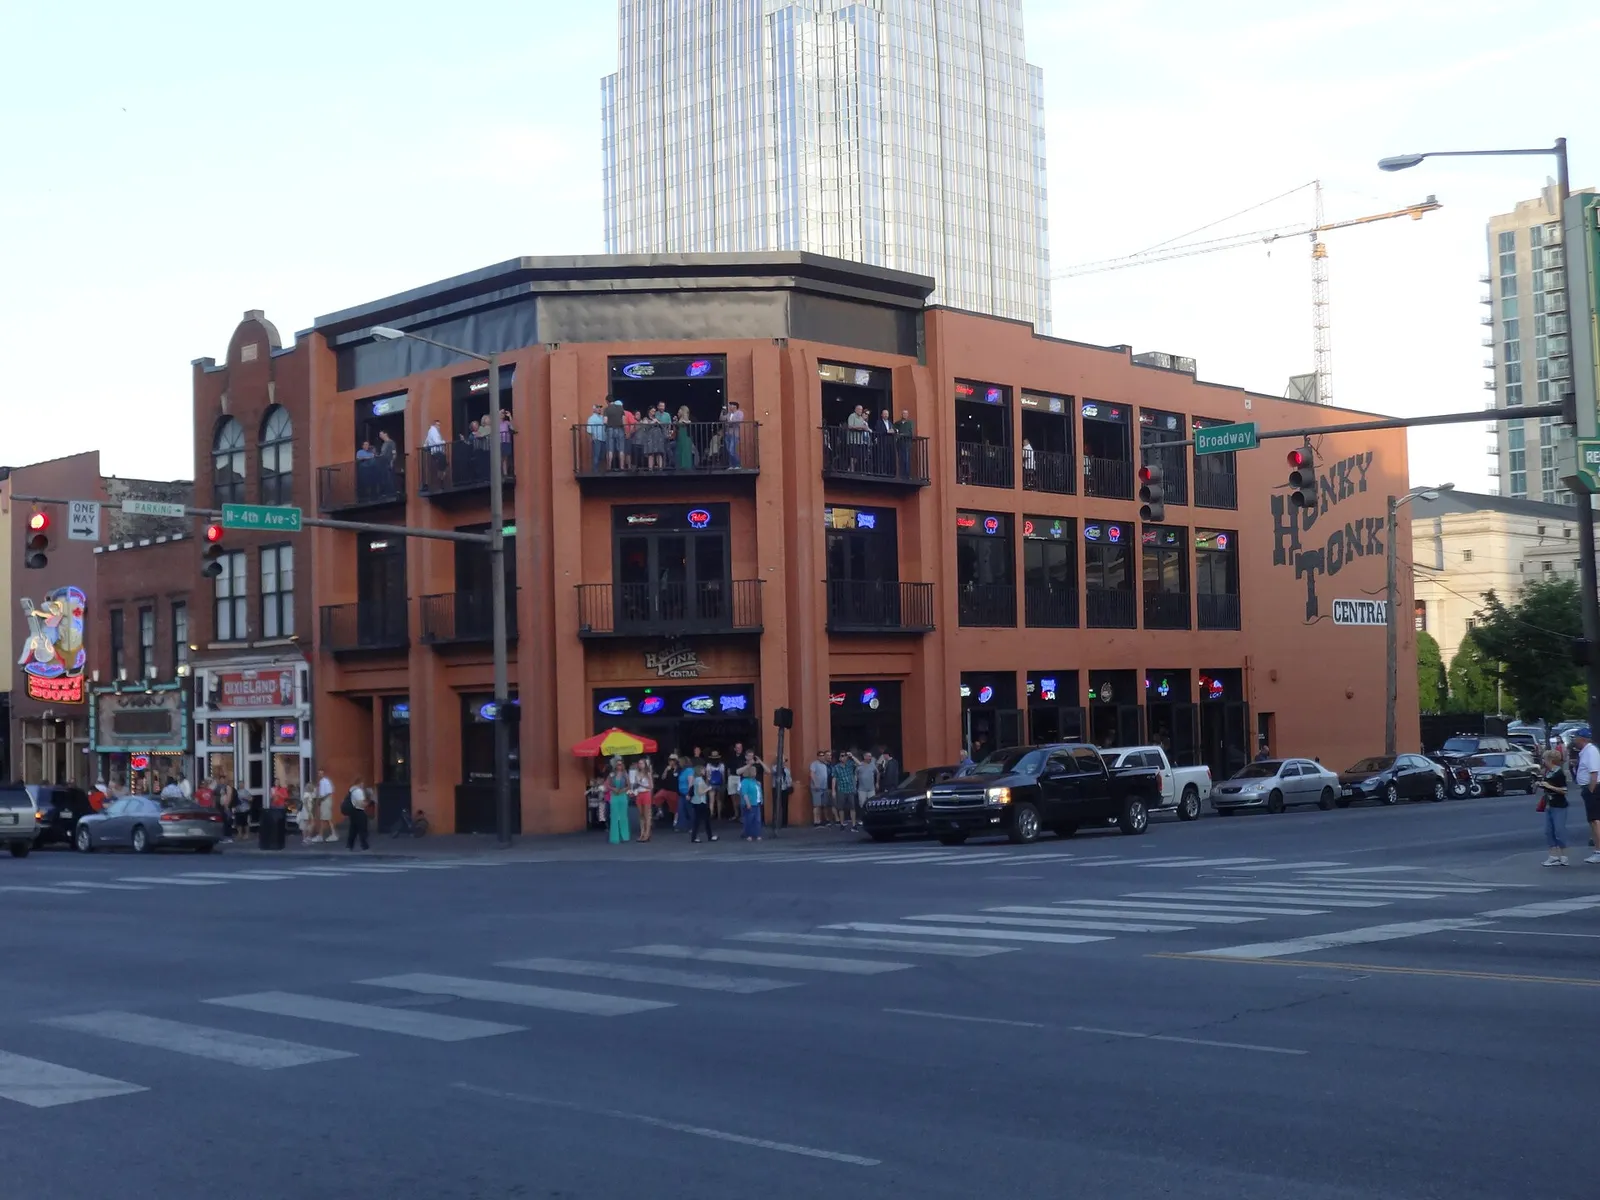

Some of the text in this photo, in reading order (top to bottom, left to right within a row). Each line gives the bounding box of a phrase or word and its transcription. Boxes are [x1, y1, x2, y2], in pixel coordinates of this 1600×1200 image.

[1199, 432, 1252, 448] Broadway
[74, 503, 95, 513] ONE
[135, 504, 172, 515] PARKING
[73, 515, 95, 525] WAY
[1295, 517, 1384, 622] TONK
[1334, 600, 1387, 624] CENTRA
